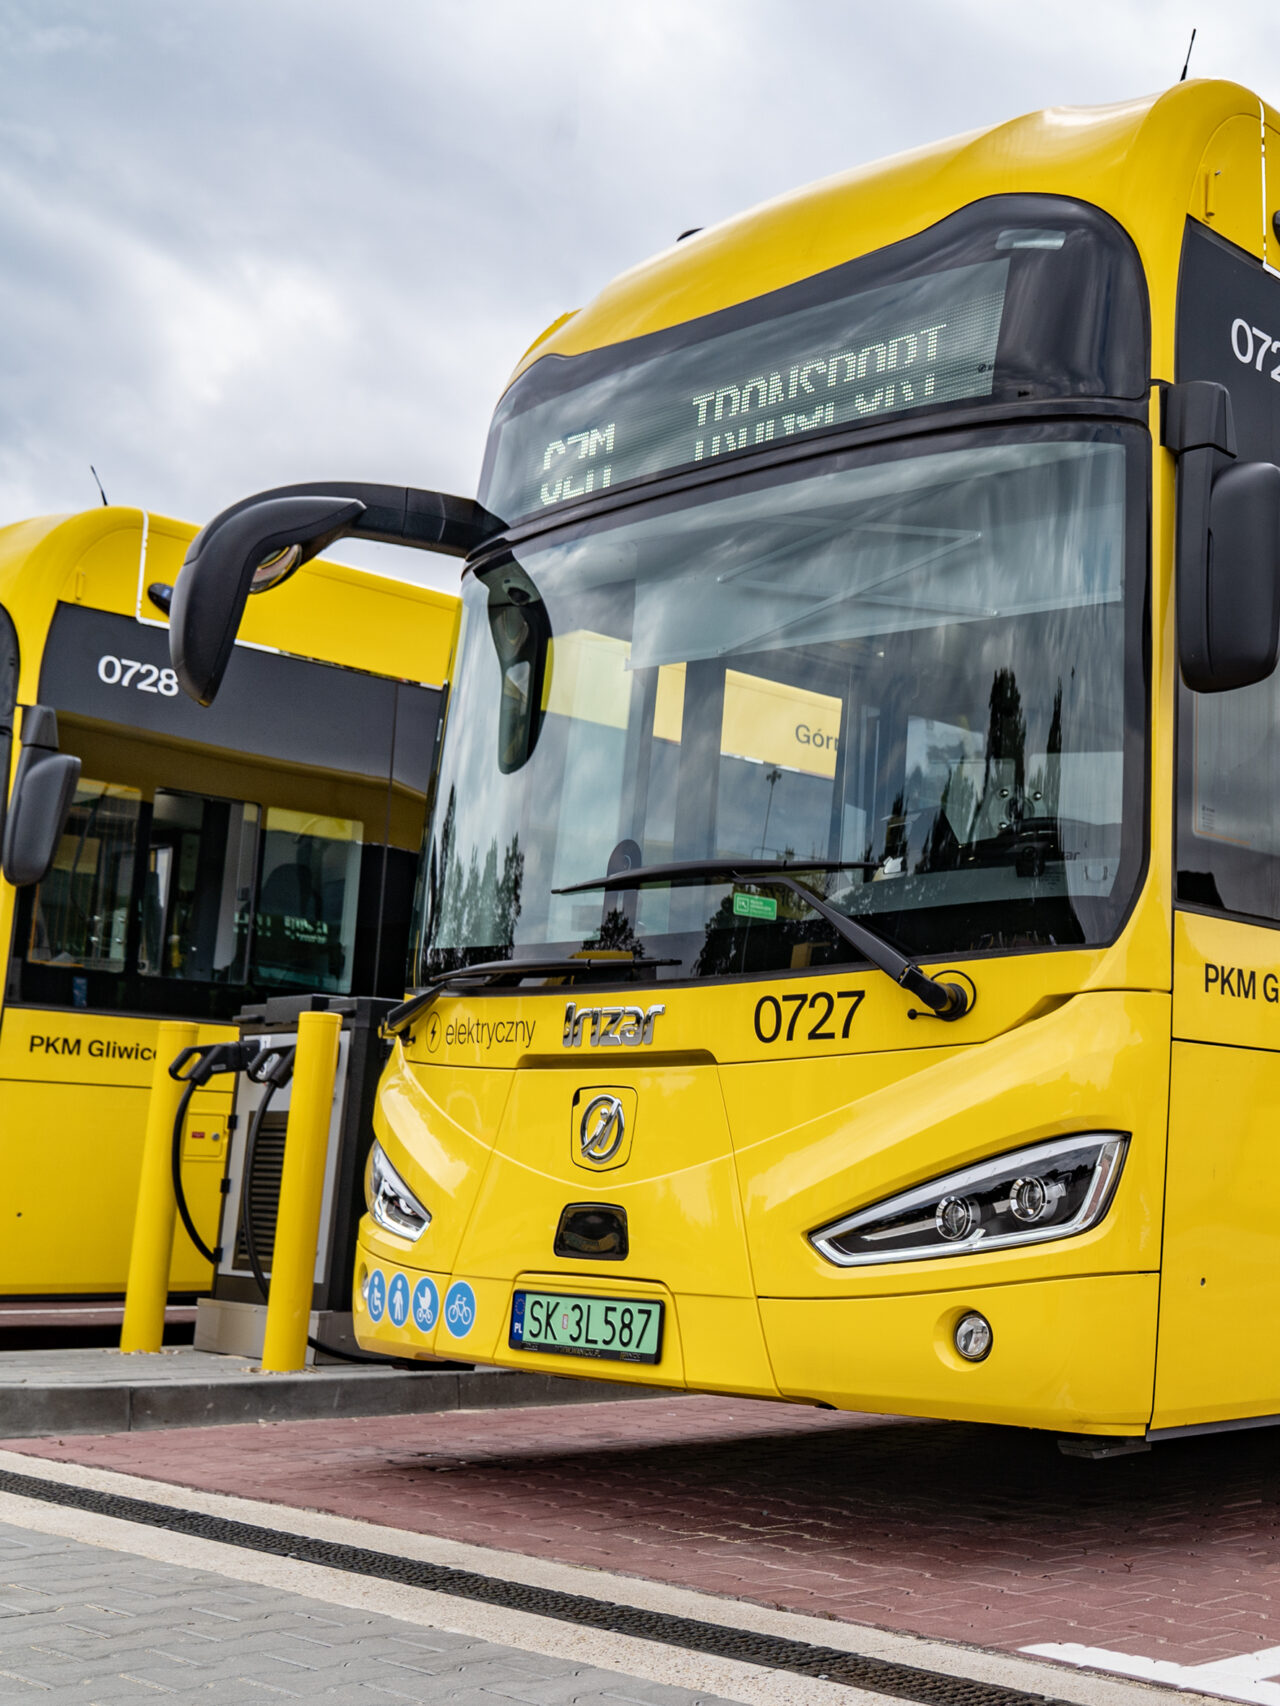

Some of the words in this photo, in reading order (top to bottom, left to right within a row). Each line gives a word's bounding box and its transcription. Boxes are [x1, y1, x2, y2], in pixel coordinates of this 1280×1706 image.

[97, 655, 179, 697] 0728
[1204, 963, 1257, 1000] PKM
[445, 1017, 536, 1049] elektryczny
[753, 989, 866, 1044] 0727
[29, 1035, 81, 1056] PKM
[514, 1322, 523, 1334] PL
[529, 1300, 561, 1340] SK
[569, 1303, 652, 1349] 3L587
